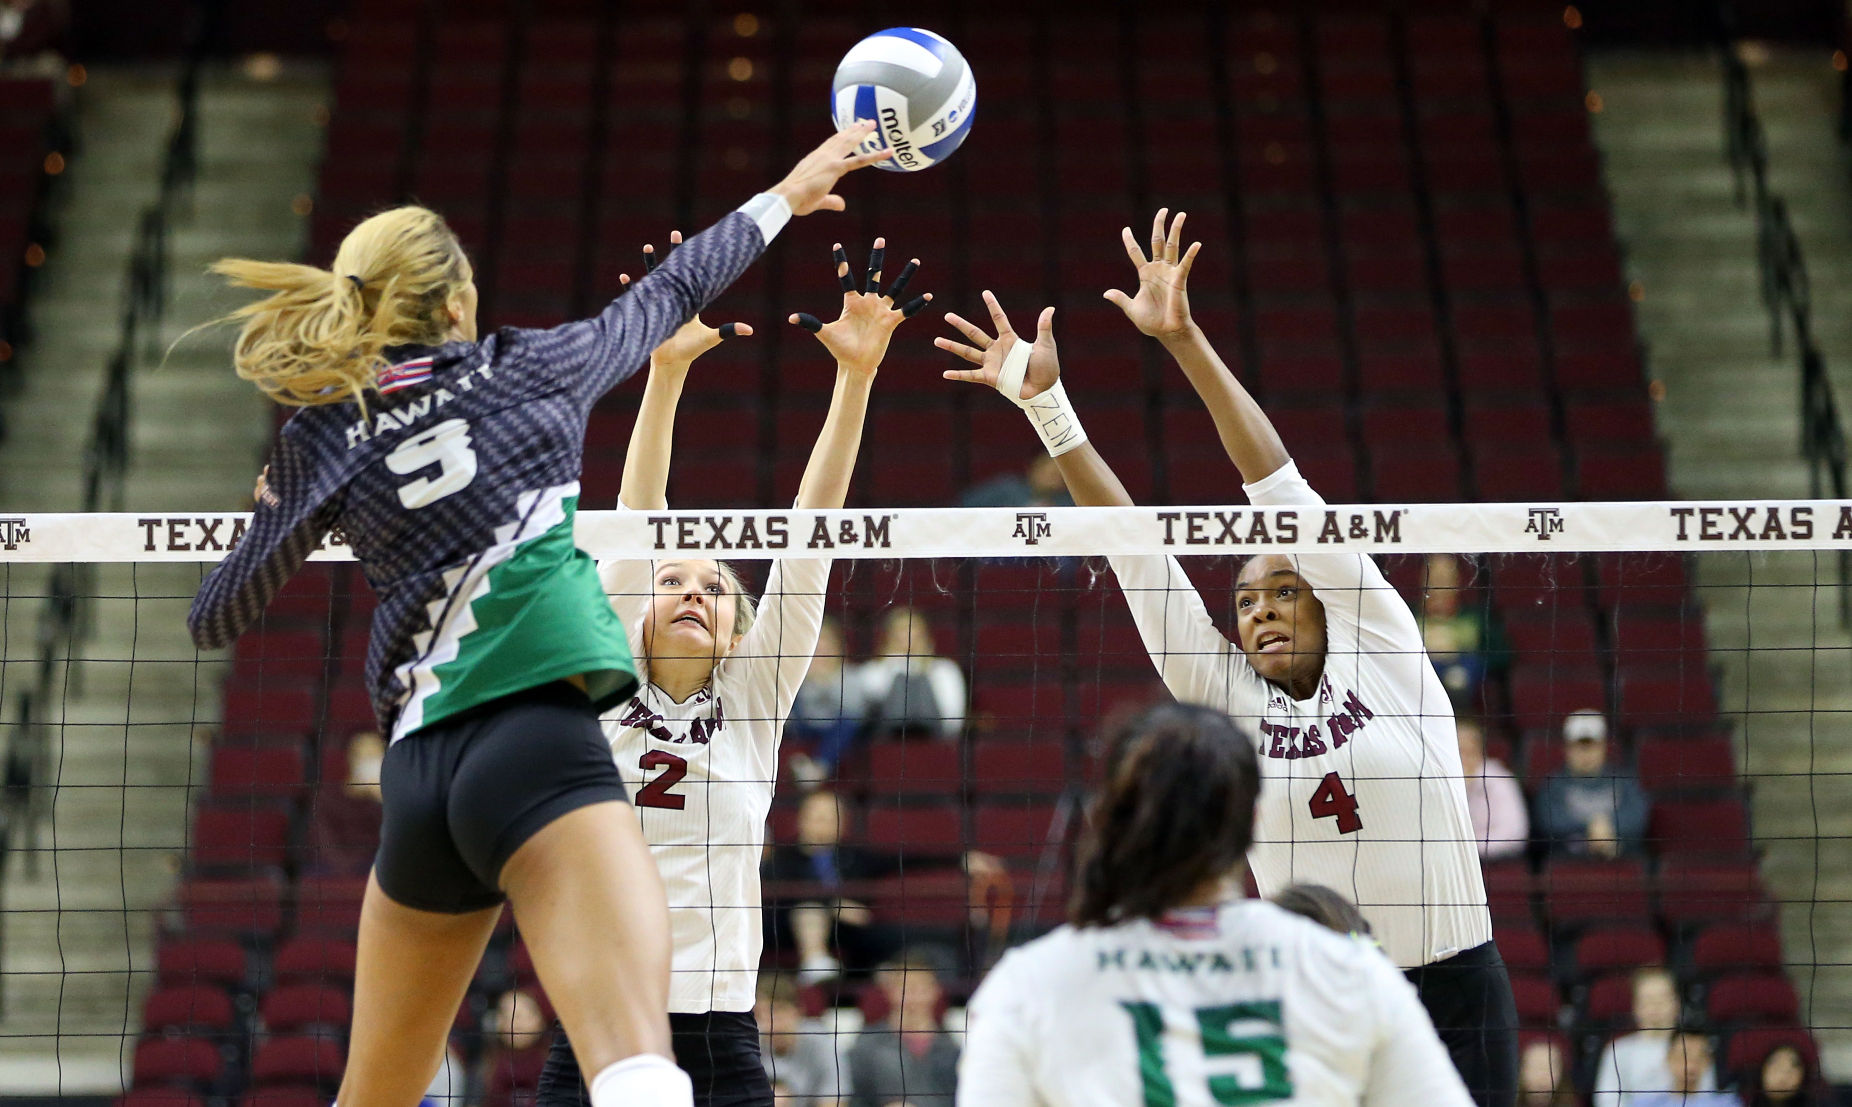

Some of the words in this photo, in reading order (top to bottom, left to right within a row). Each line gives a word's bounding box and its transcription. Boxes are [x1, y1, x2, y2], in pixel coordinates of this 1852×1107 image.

[881, 107, 920, 169] molten
[1030, 393, 1078, 448] ZEN
[385, 418, 477, 510] 9
[648, 516, 788, 549] TEXAS
[807, 515, 891, 548] A&M
[1157, 511, 1298, 545] TEXAS
[1317, 510, 1401, 543] A&M
[1670, 507, 1813, 540] TEXAS
[635, 749, 687, 811] 2
[1309, 771, 1363, 835] 4
[1117, 999, 1294, 1107] 15
